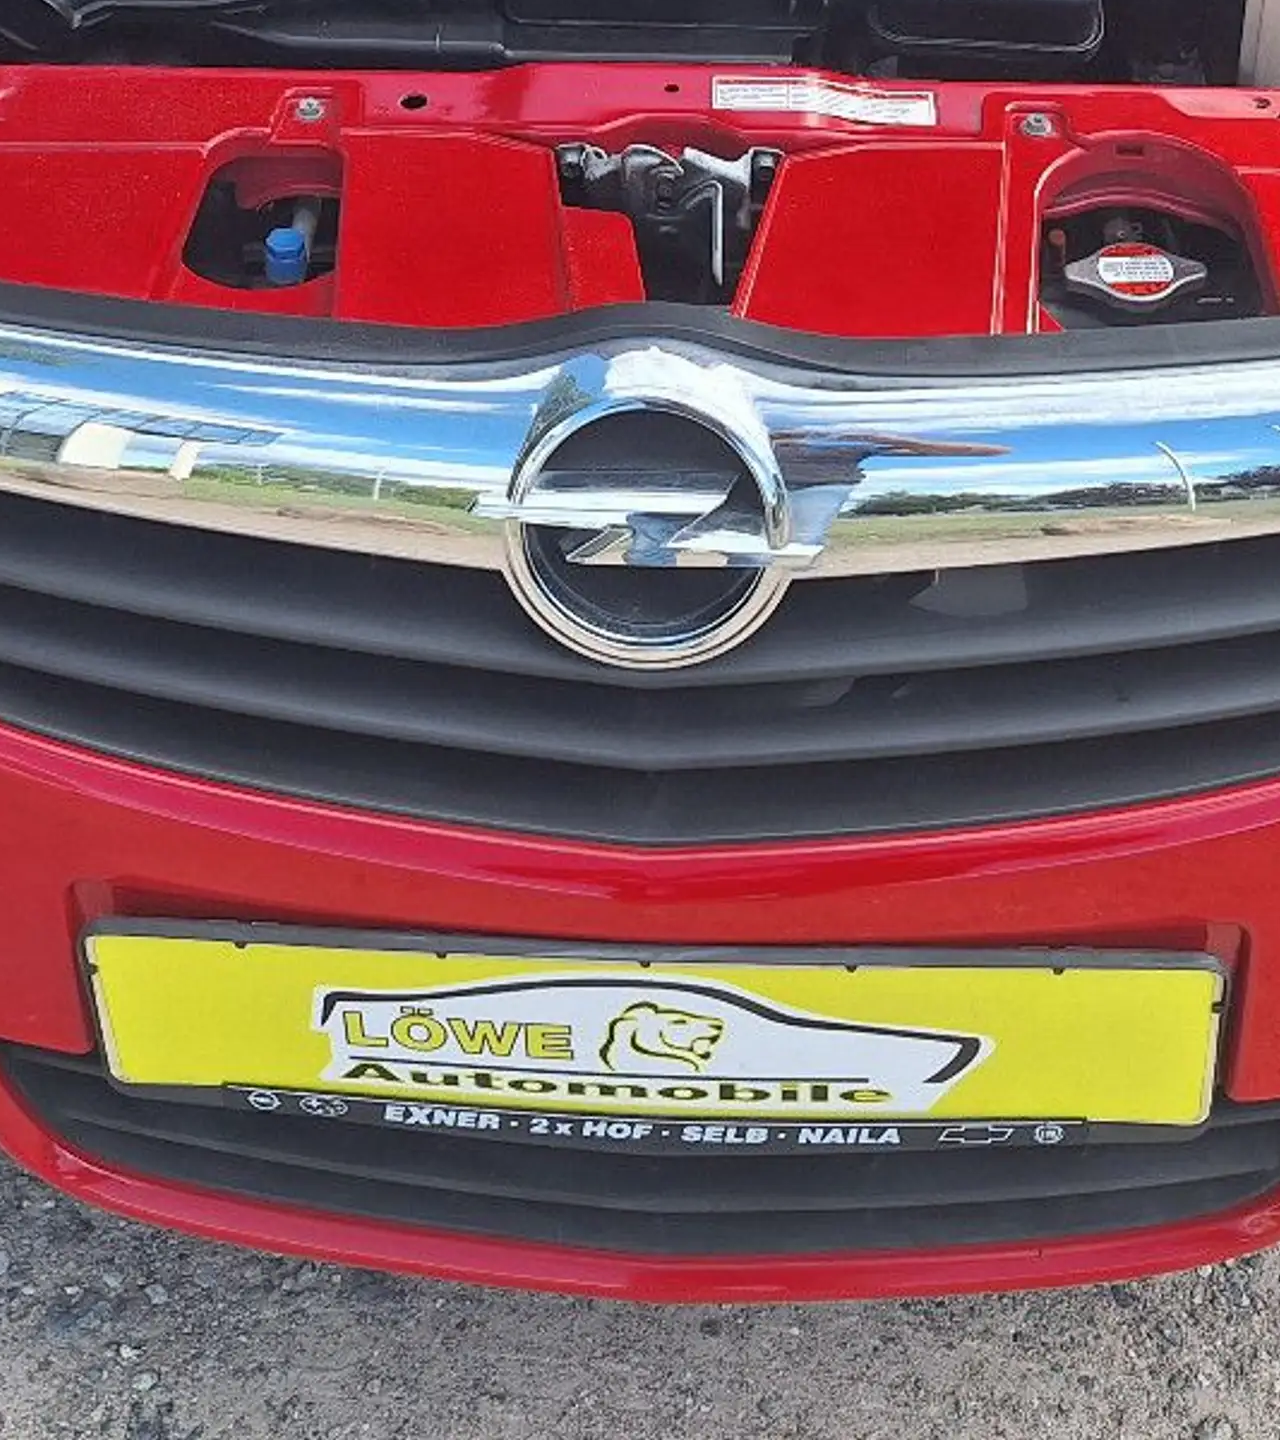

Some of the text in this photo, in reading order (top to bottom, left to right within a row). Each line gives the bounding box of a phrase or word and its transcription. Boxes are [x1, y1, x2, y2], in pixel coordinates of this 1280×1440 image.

[342, 1006, 574, 1061] LÖWE
[341, 1062, 893, 1103] Automobile
[383, 1104, 501, 1130] EXNER
[582, 1121, 654, 1140] HOF
[680, 1125, 769, 1144] SELB
[798, 1127, 901, 1145] NAILA
